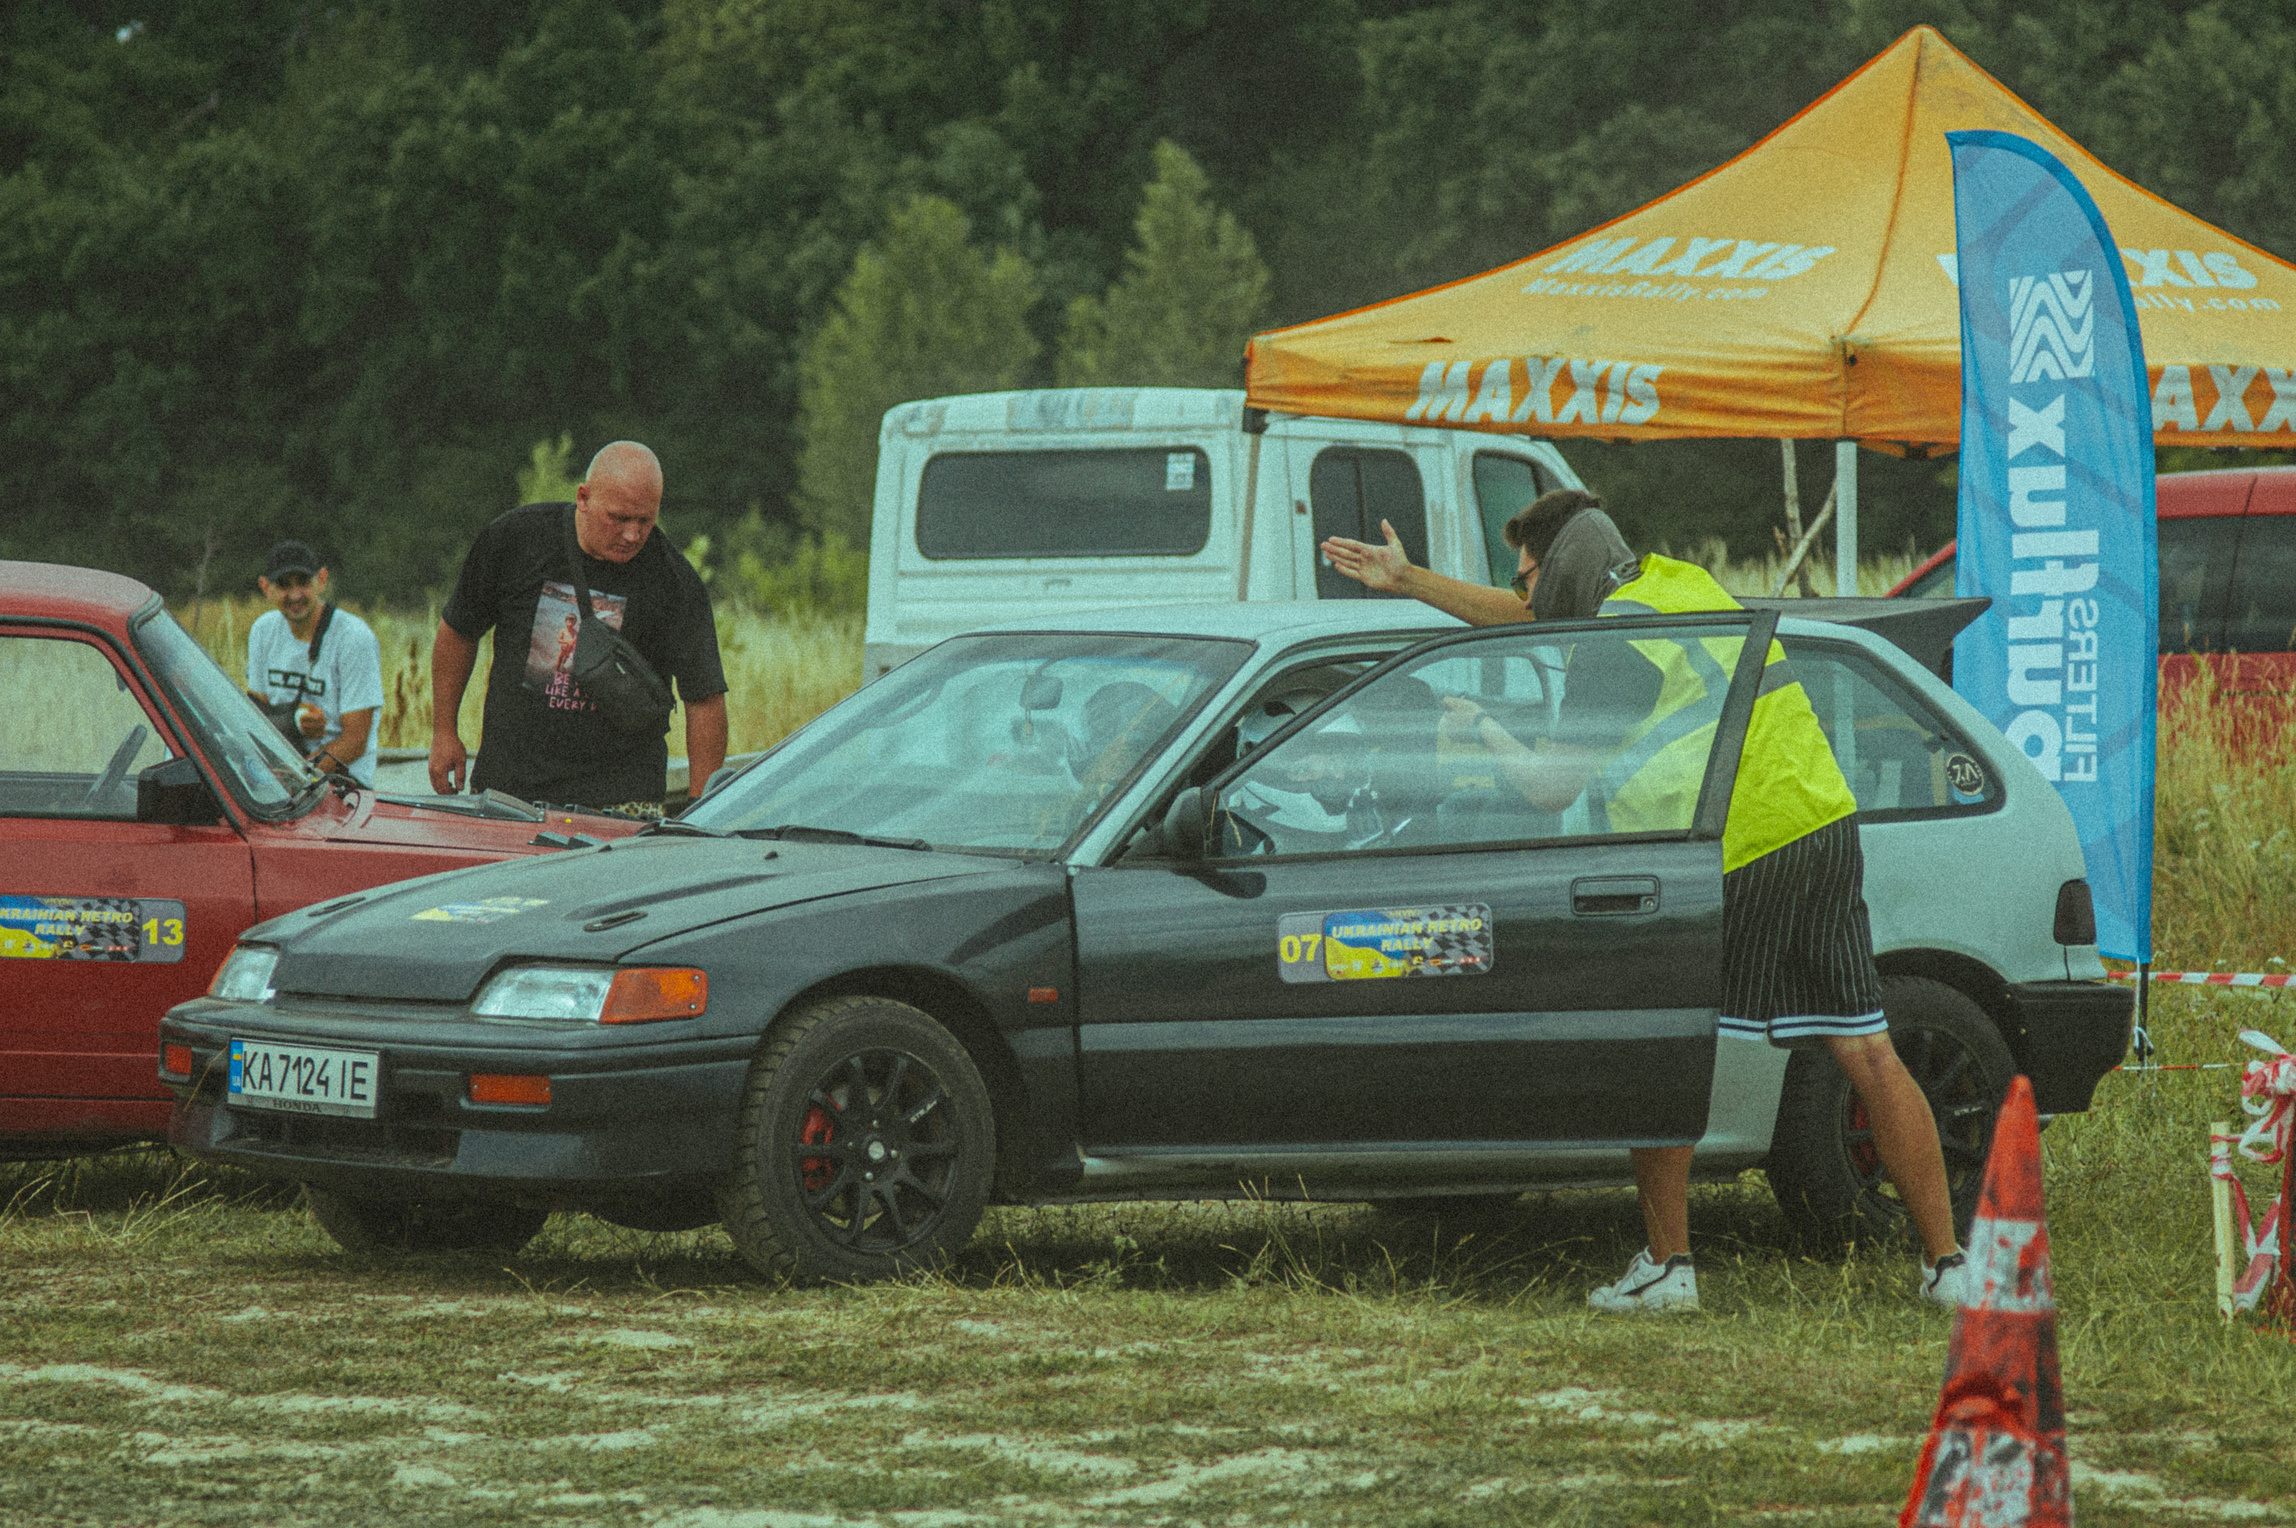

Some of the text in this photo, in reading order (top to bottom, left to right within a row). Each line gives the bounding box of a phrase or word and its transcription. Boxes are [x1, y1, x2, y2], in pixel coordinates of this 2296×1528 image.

[1542, 236, 1837, 280] MAXXIS
[1405, 357, 1666, 425] MAXXIS
[549, 696, 587, 711] EVERY
[0, 907, 134, 924] KRAINIAN RETRO
[34, 923, 86, 936] RALLY
[142, 917, 184, 946] 13
[1332, 918, 1483, 938] UKRAINIAN RETRO
[1279, 933, 1322, 964] 07
[1381, 937, 1434, 951] RALLY
[340, 1059, 369, 1101] IE
[272, 1099, 322, 1113] HONDA
